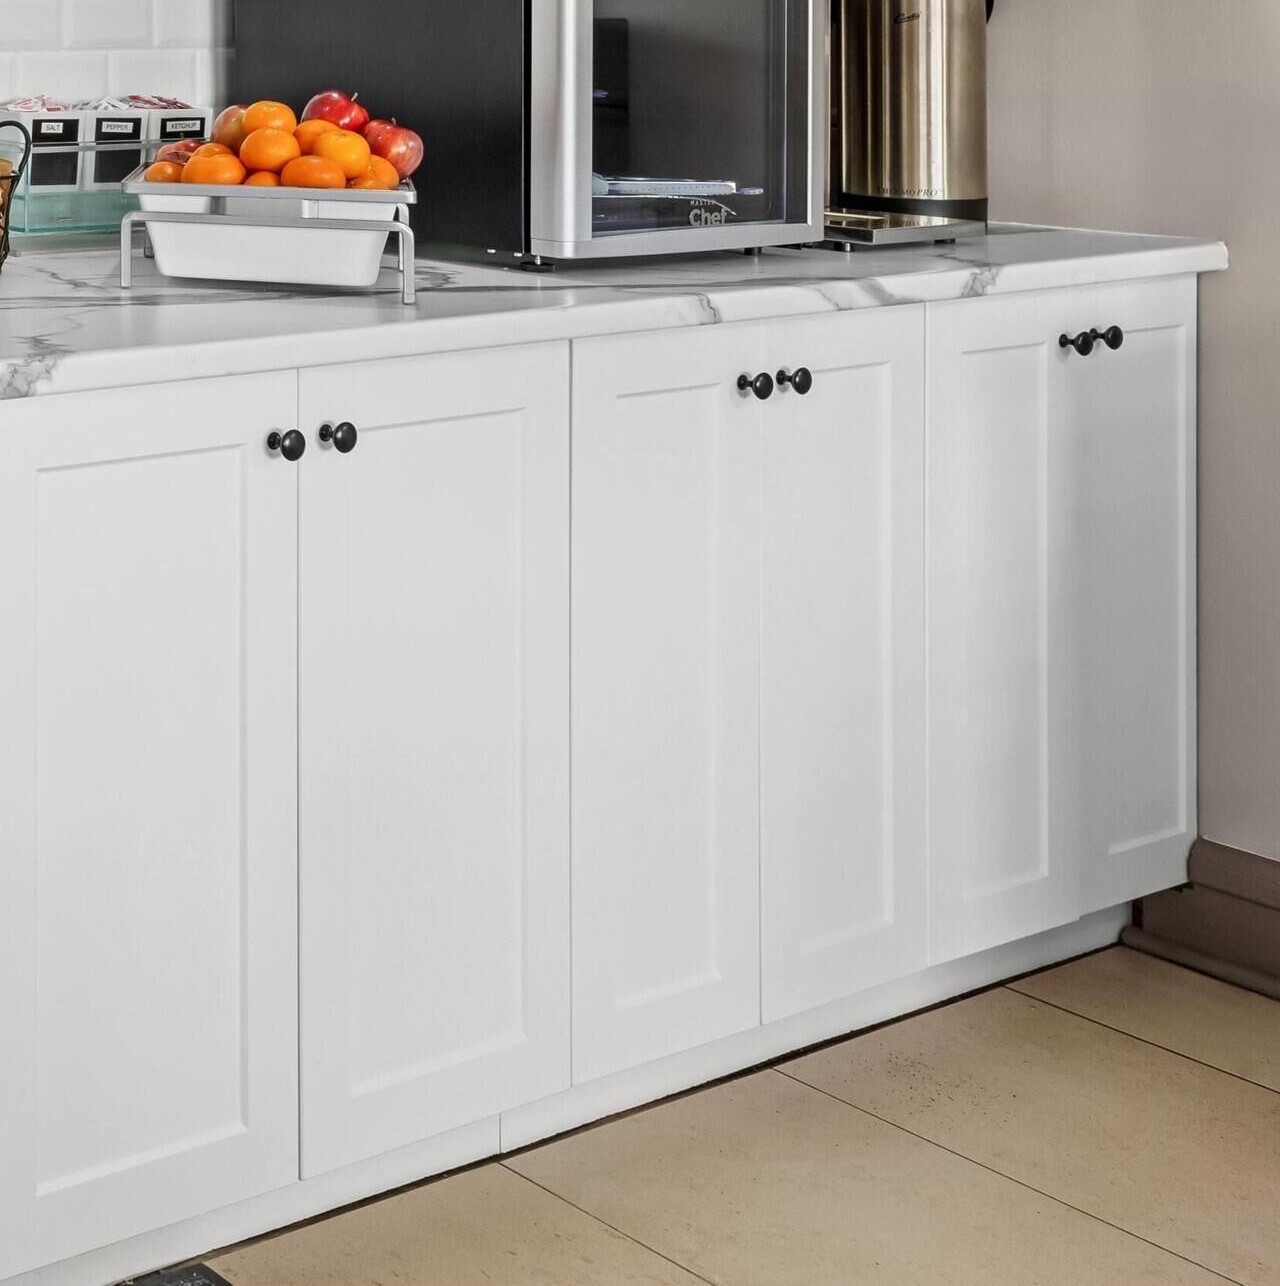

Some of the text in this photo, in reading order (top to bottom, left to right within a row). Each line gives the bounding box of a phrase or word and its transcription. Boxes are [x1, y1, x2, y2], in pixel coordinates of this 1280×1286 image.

[46, 123, 61, 131] SALT
[105, 123, 129, 131] PEPPER
[170, 122, 197, 130] KETCHUP
[689, 208, 727, 226] Chef
